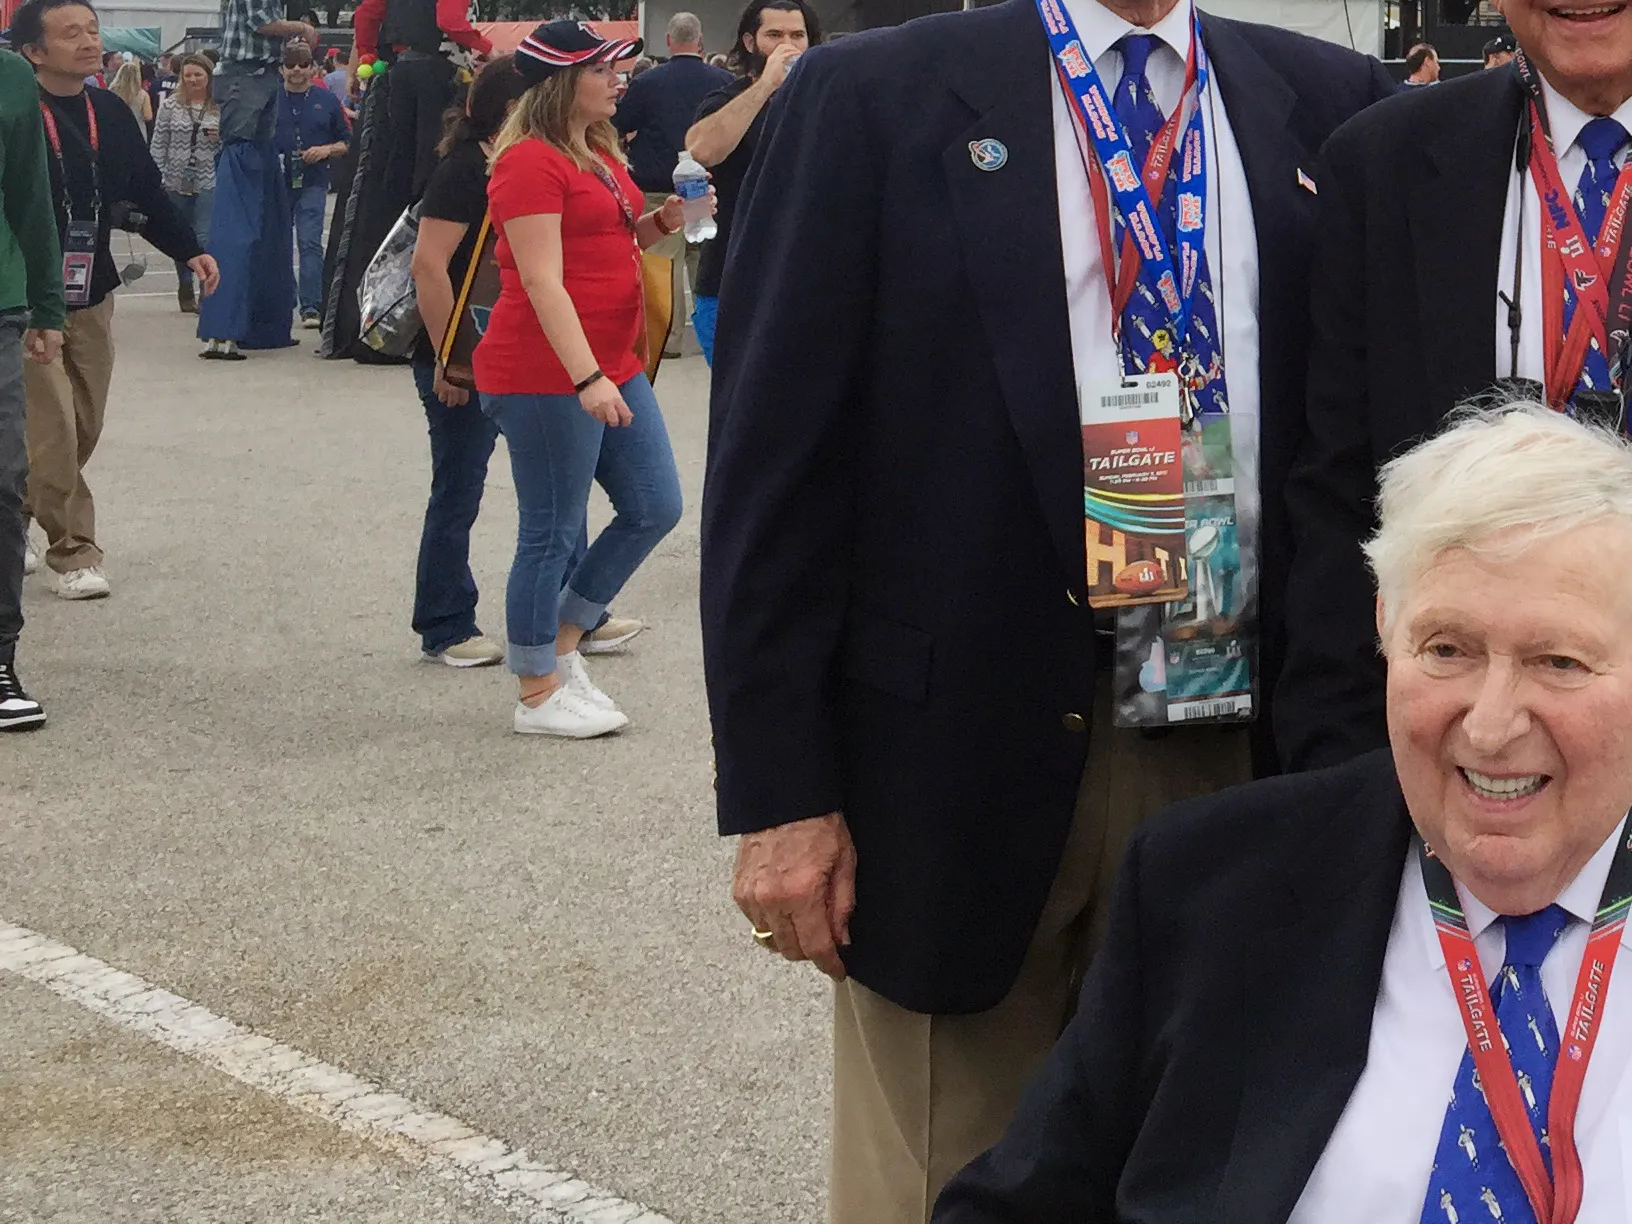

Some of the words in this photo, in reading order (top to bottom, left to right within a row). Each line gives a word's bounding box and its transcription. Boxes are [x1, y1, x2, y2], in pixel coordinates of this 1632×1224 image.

[1544, 188, 1571, 230] NFC
[1089, 451, 1176, 471] TAILGATE
[1460, 973, 1493, 1053] TAILGATE
[1575, 958, 1605, 1043] TAILGATE
